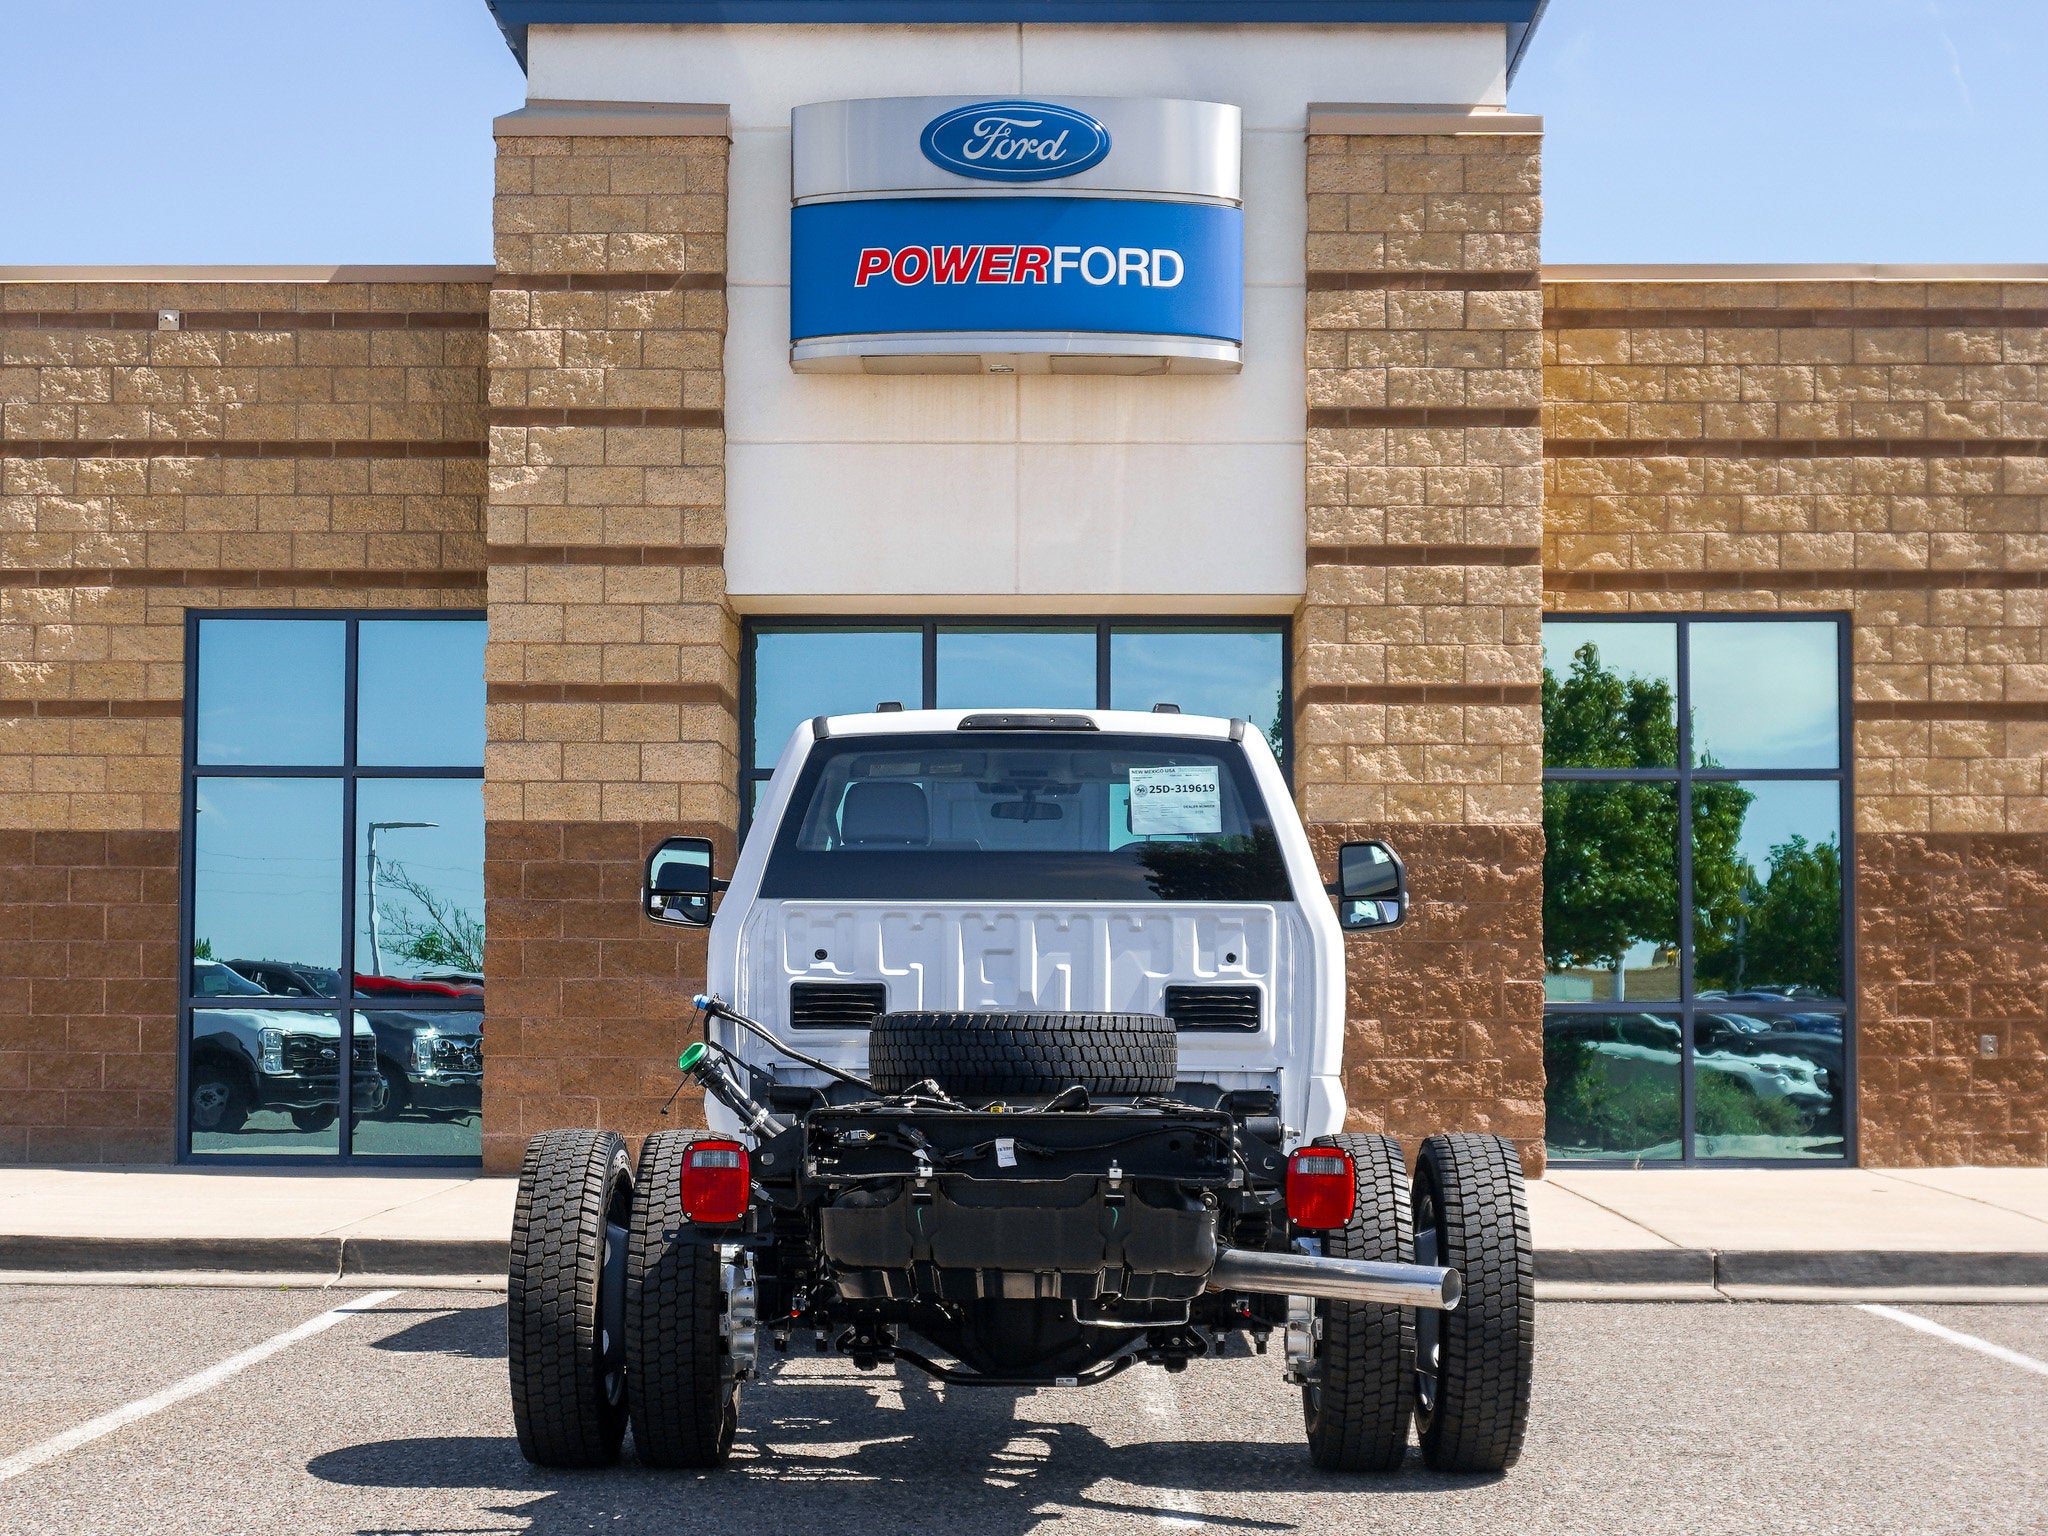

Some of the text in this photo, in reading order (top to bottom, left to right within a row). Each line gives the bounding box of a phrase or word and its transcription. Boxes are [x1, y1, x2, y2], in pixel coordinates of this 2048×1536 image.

[962, 116, 1070, 161] Ford
[854, 244, 1185, 288] POWERFORD
[1149, 784, 1215, 794] 25D-319619
